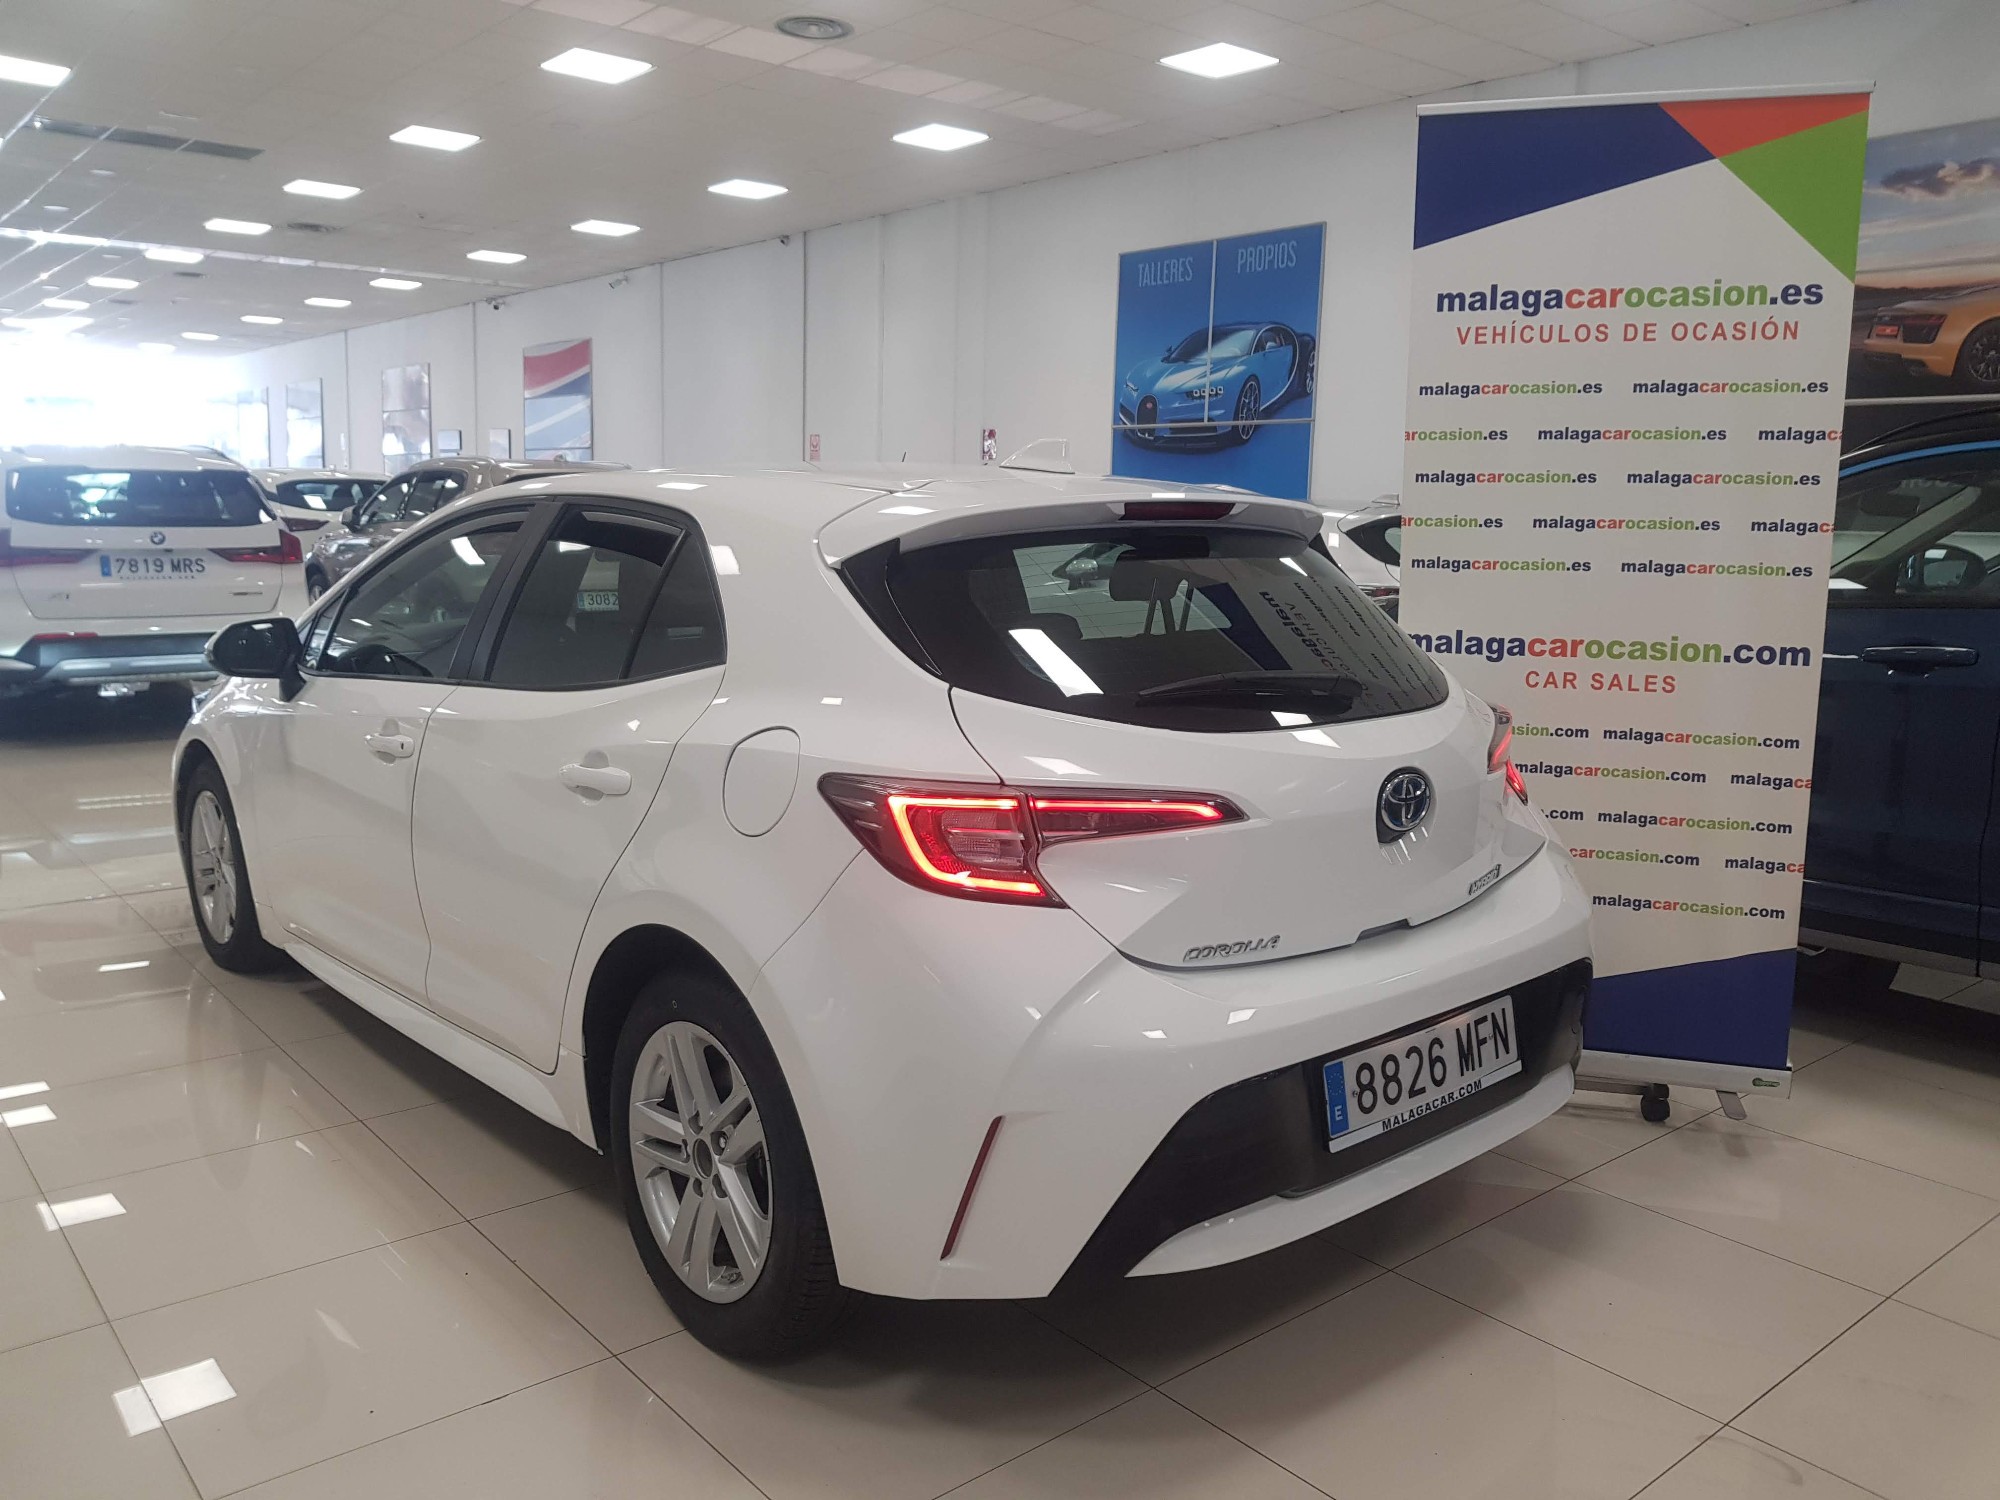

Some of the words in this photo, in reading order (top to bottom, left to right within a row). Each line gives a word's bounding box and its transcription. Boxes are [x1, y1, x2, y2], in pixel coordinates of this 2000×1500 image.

[1138, 257, 1194, 287] TALLERES
[1237, 240, 1298, 274] PROPIOS
[1436, 279, 1824, 317] malagacarocasion.es
[1456, 320, 1609, 345] VEHÍCULOS
[1623, 323, 1657, 342] DE
[1671, 315, 1799, 342] OCASIÓN
[1419, 380, 1603, 399] malagacarocasion.es
[1632, 378, 1829, 397] malagacarocasion.es
[1537, 426, 1727, 444] malagacarocasion.es
[1415, 470, 1597, 487] malagacarocasion.es
[1627, 470, 1821, 488] malagacarocasion.es
[1533, 515, 1721, 533] malagacarocasion.es
[115, 557, 165, 574] 7819
[170, 557, 206, 574] MRS
[1411, 556, 1592, 573] malagacarocasion.es
[1621, 559, 1813, 577] malagacarocasion.es
[1407, 629, 1811, 667] malagacarocasion.com
[1525, 671, 1578, 690] CAR
[1591, 673, 1677, 694] SALES
[1603, 727, 1800, 749] malagacarocasion.com
[1515, 761, 1707, 783] malagacarocasion.com
[1598, 810, 1793, 834] malagacarocasion.com
[1592, 894, 1786, 919] malagacarocasion.com
[1182, 934, 1281, 962] COROLLA
[1355, 1036, 1447, 1115] 8826
[1455, 1007, 1511, 1077] MFN
[1381, 1078, 1483, 1132] MALAGACAR.COM
